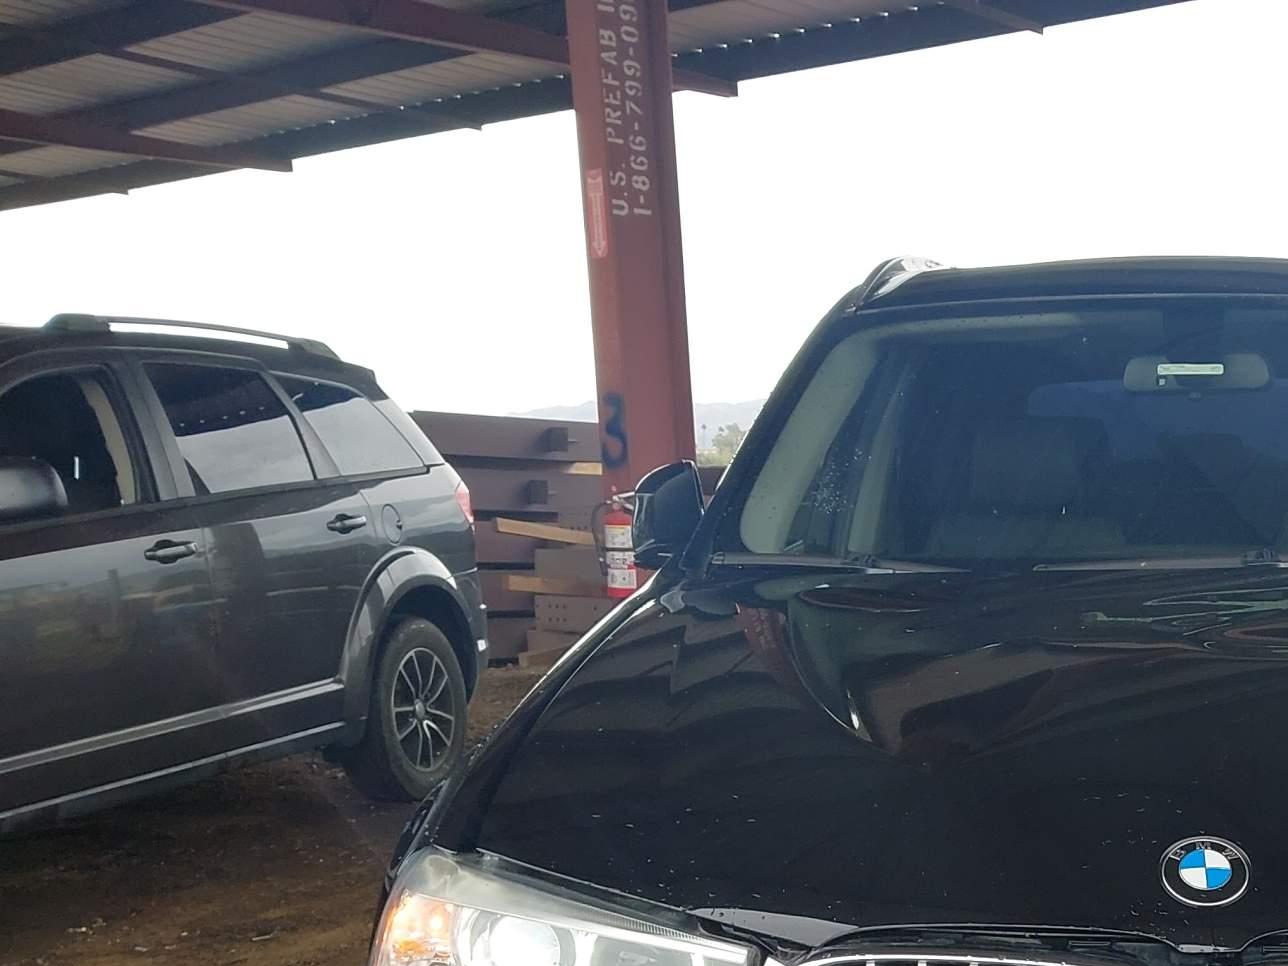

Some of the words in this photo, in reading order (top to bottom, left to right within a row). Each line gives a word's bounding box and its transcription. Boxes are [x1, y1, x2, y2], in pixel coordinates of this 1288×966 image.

[600, 28, 624, 144] PREFAB
[620, 0, 652, 215] 1-866-799-09
[609, 163, 629, 216] U.S.
[602, 391, 630, 468] 3
[1169, 841, 1241, 861] BMW
